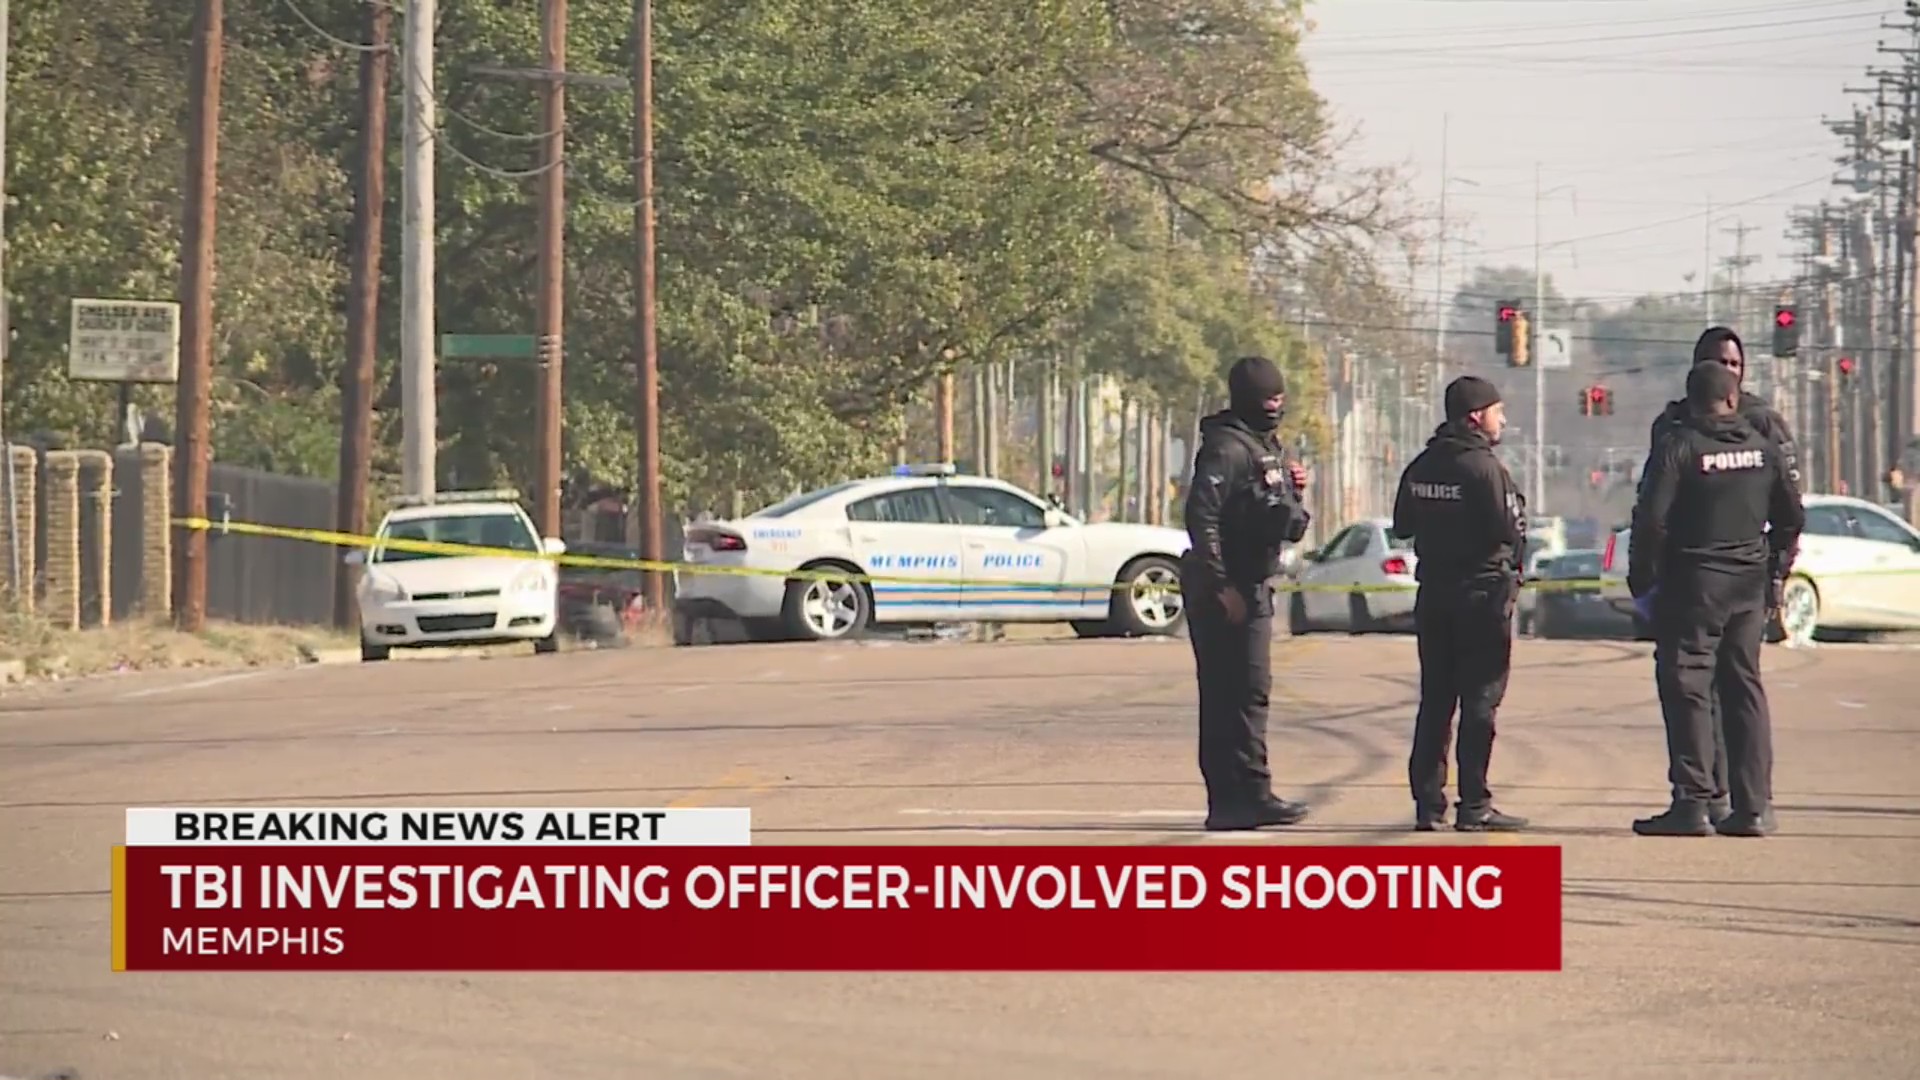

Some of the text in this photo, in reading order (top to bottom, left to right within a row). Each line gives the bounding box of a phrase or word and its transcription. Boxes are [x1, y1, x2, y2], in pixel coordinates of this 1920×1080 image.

[1702, 450, 1764, 471] POLICE
[1409, 482, 1462, 500] POLICE
[869, 554, 1043, 569] MEMPHIS POLICE
